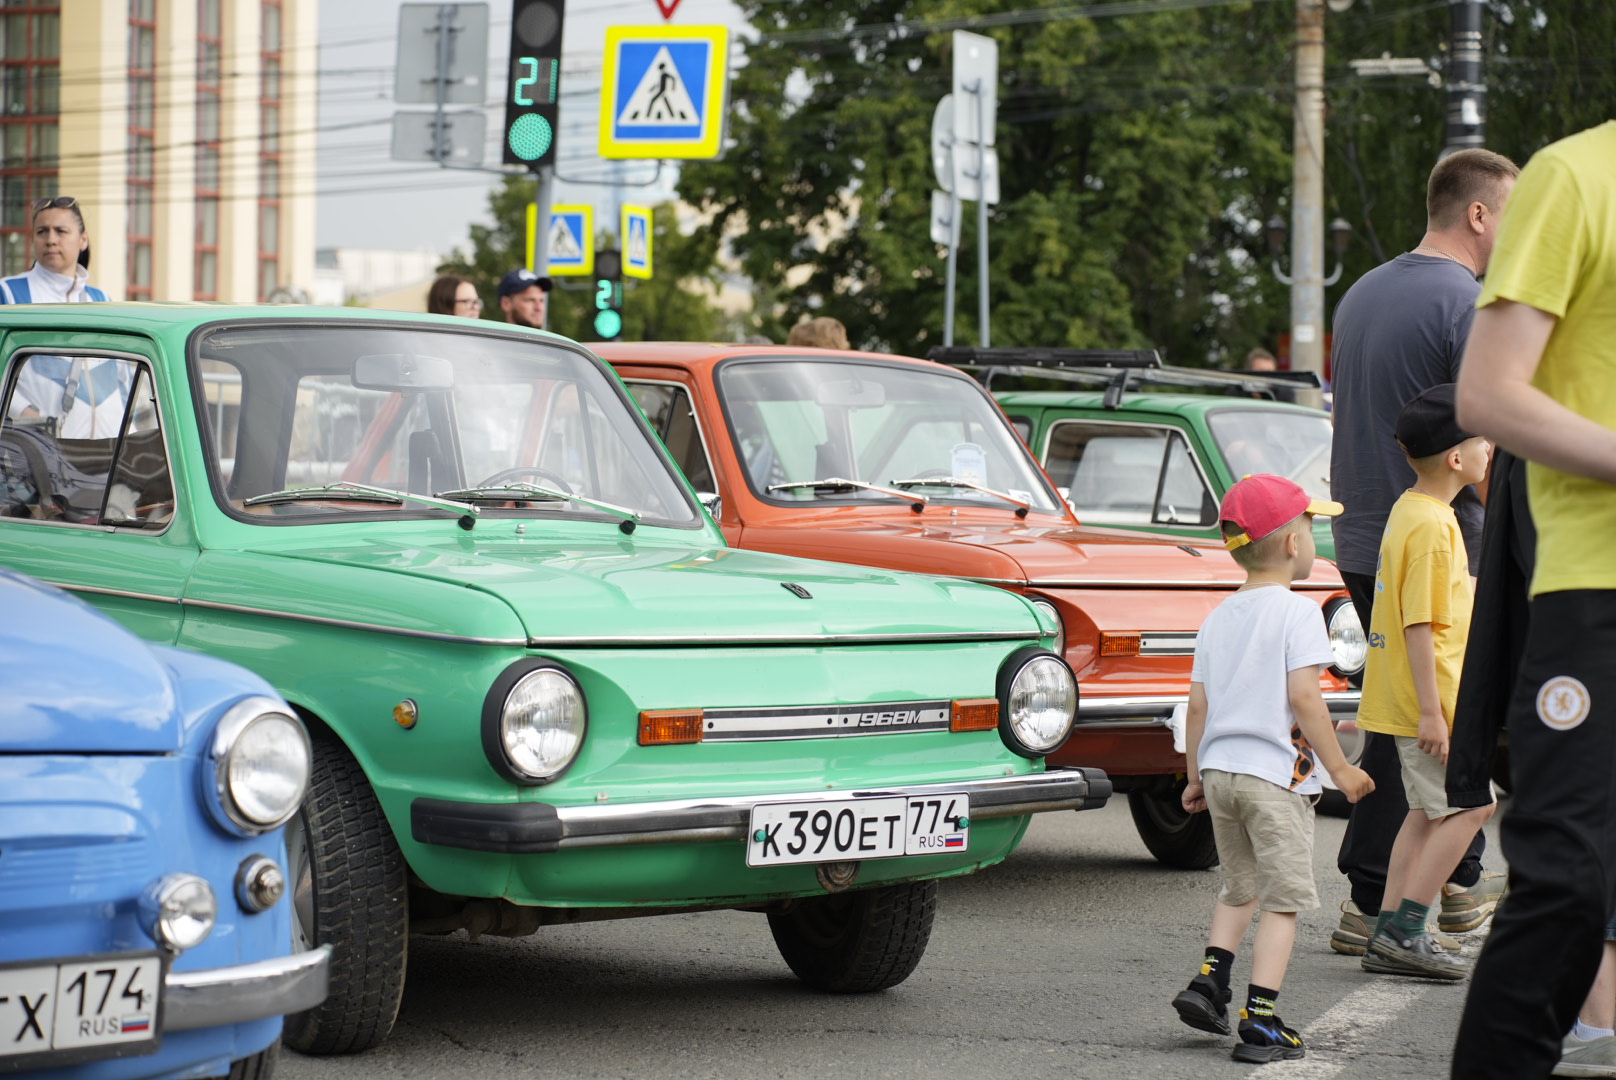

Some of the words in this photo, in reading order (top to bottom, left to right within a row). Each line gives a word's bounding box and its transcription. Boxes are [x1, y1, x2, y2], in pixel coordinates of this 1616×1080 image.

[514, 57, 558, 105] 21
[762, 808, 901, 858] K390ET
[910, 800, 959, 835] 774
[919, 836, 944, 849] RUS
[0, 993, 47, 1042] X
[67, 966, 143, 1017] 174
[79, 1017, 119, 1037] RUS
